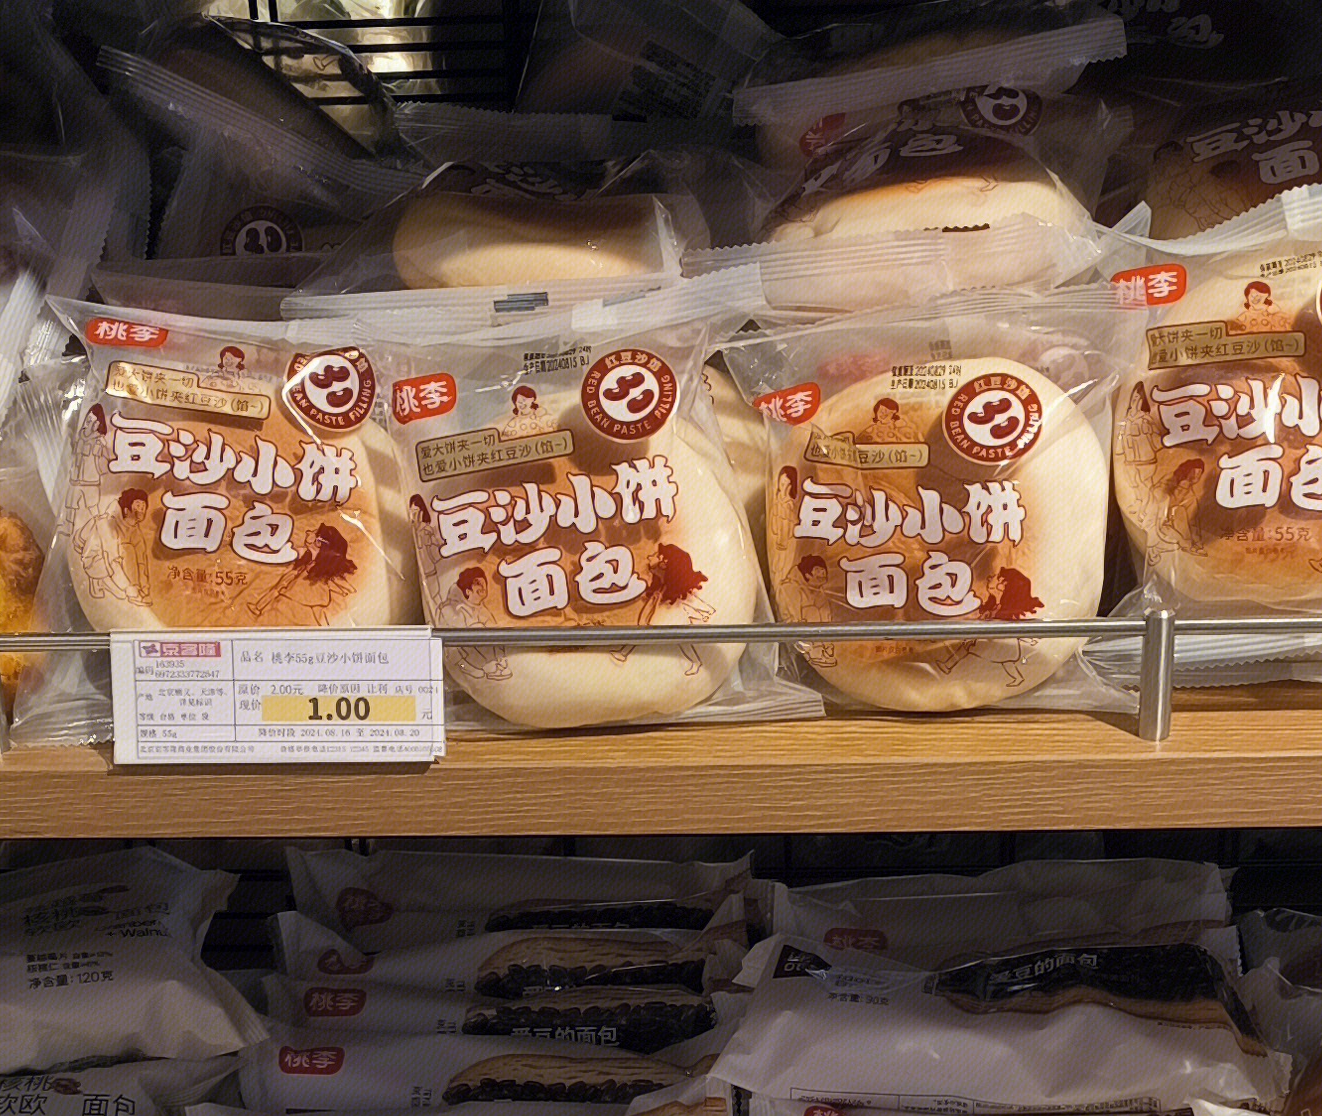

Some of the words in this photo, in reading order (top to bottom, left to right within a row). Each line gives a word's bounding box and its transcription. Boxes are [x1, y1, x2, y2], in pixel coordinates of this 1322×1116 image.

[1115, 271, 1178, 304] 桃李
[94, 321, 160, 342] 桃李
[394, 380, 452, 417] 桃李
[420, 430, 496, 459] 爱大饼夹一切
[612, 420, 653, 437] PASTE
[108, 410, 362, 507] 豆沙小饼
[971, 444, 1014, 461] PASTE
[430, 454, 680, 560] 豆沙小饼
[794, 478, 1026, 548] 豆沙小饼
[158, 491, 299, 565] 面包
[497, 541, 646, 620] 面包
[844, 552, 983, 617] 面包
[307, 697, 371, 720] 1.00
[309, 991, 359, 1012] 桃李
[284, 1050, 336, 1070] 桃李
